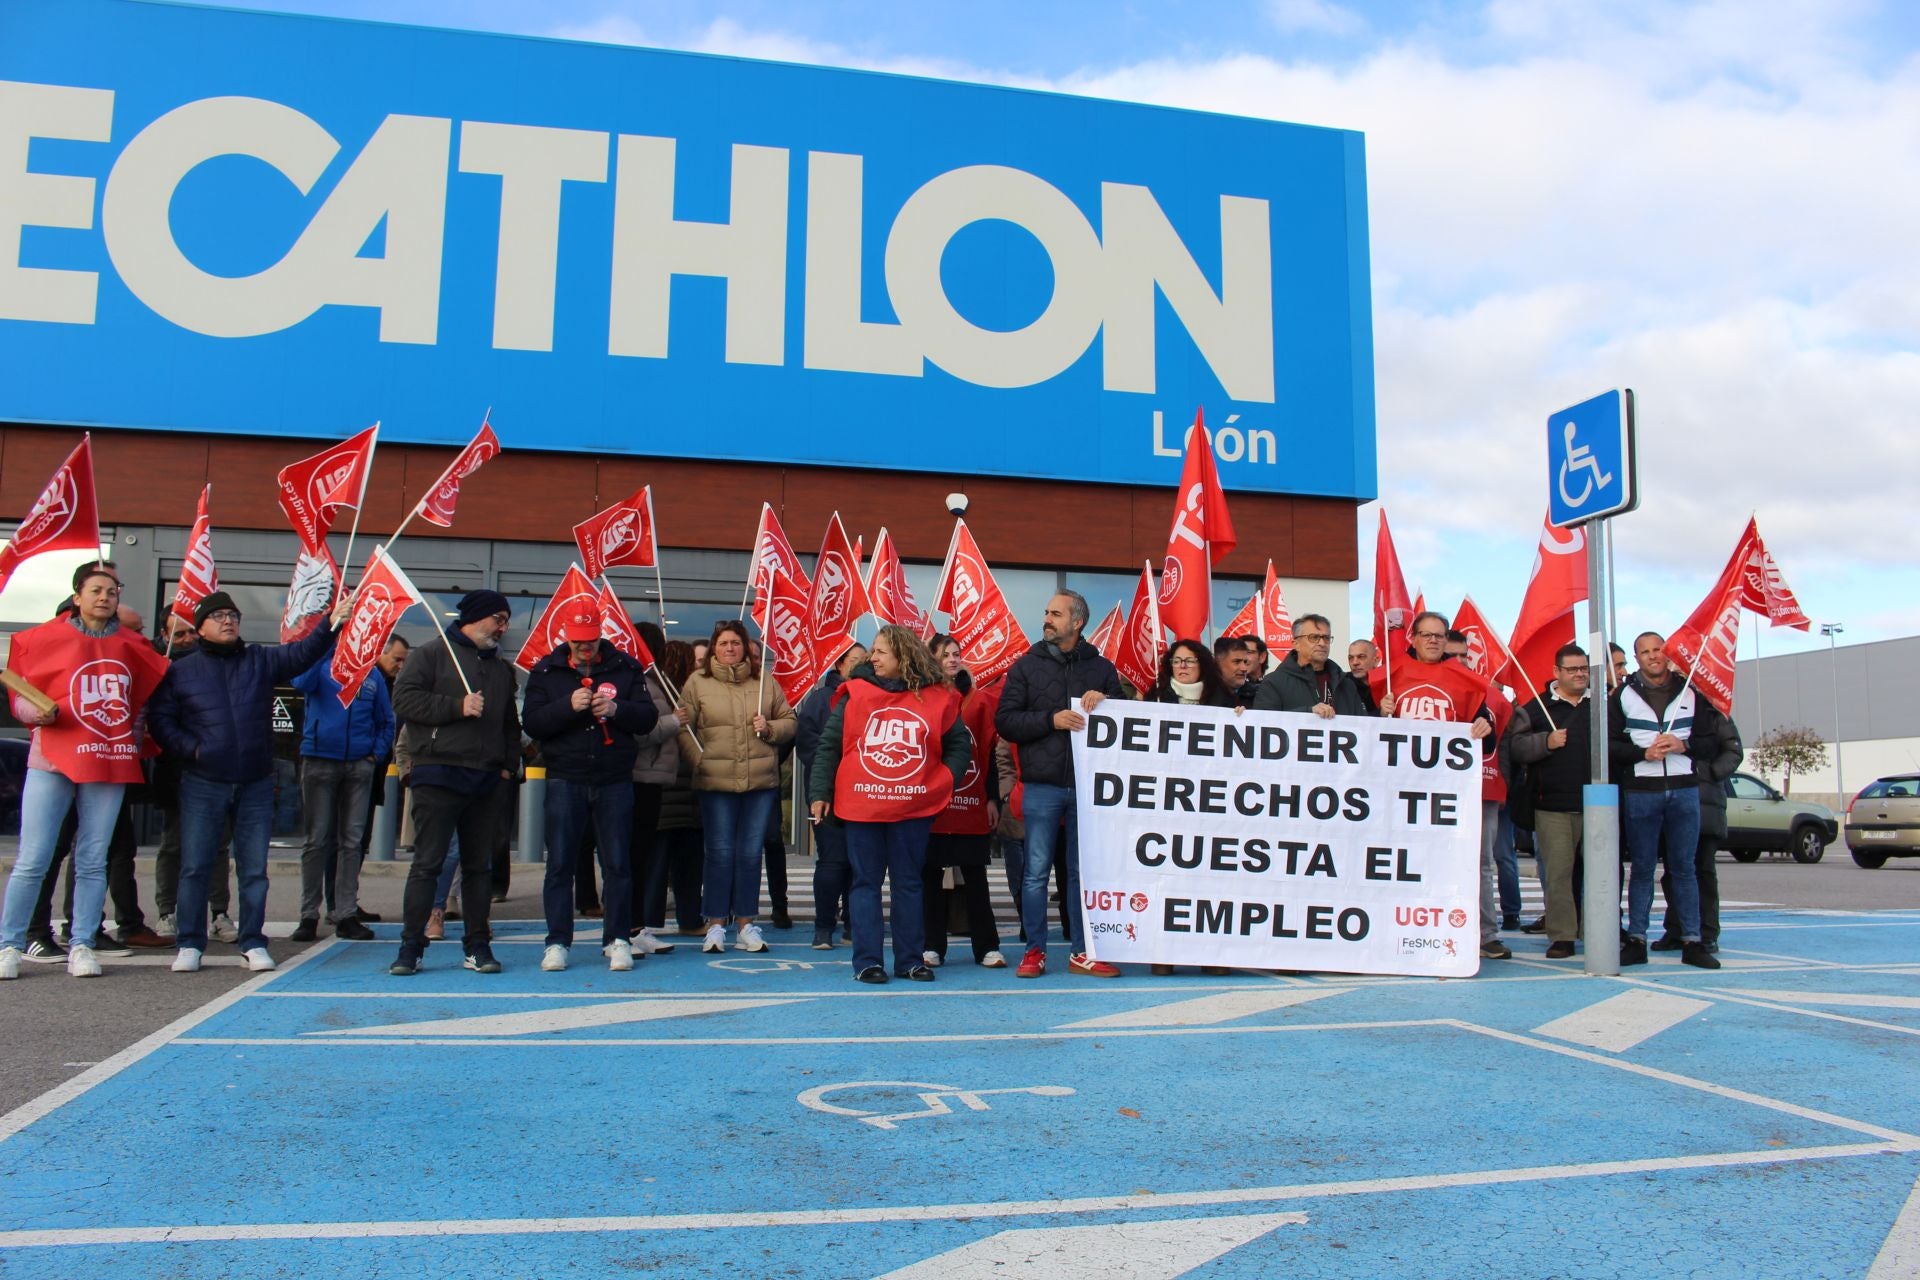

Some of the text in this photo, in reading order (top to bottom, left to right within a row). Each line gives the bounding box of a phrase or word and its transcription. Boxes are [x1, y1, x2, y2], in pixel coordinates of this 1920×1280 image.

[80, 673, 130, 706] UGT
[1399, 695, 1450, 721] UGT
[865, 718, 920, 746] UGT
[1086, 714, 1474, 771] DEFENDER TUS
[854, 783, 885, 793] mano
[1093, 772, 1458, 826] DERECHOS TE
[1135, 832, 1422, 882] CUESTA EL
[1084, 889, 1126, 911] UGT
[1163, 897, 1371, 942] EMPLEO
[1395, 906, 1444, 927] UGT
[1402, 937, 1441, 949] FeSMC
